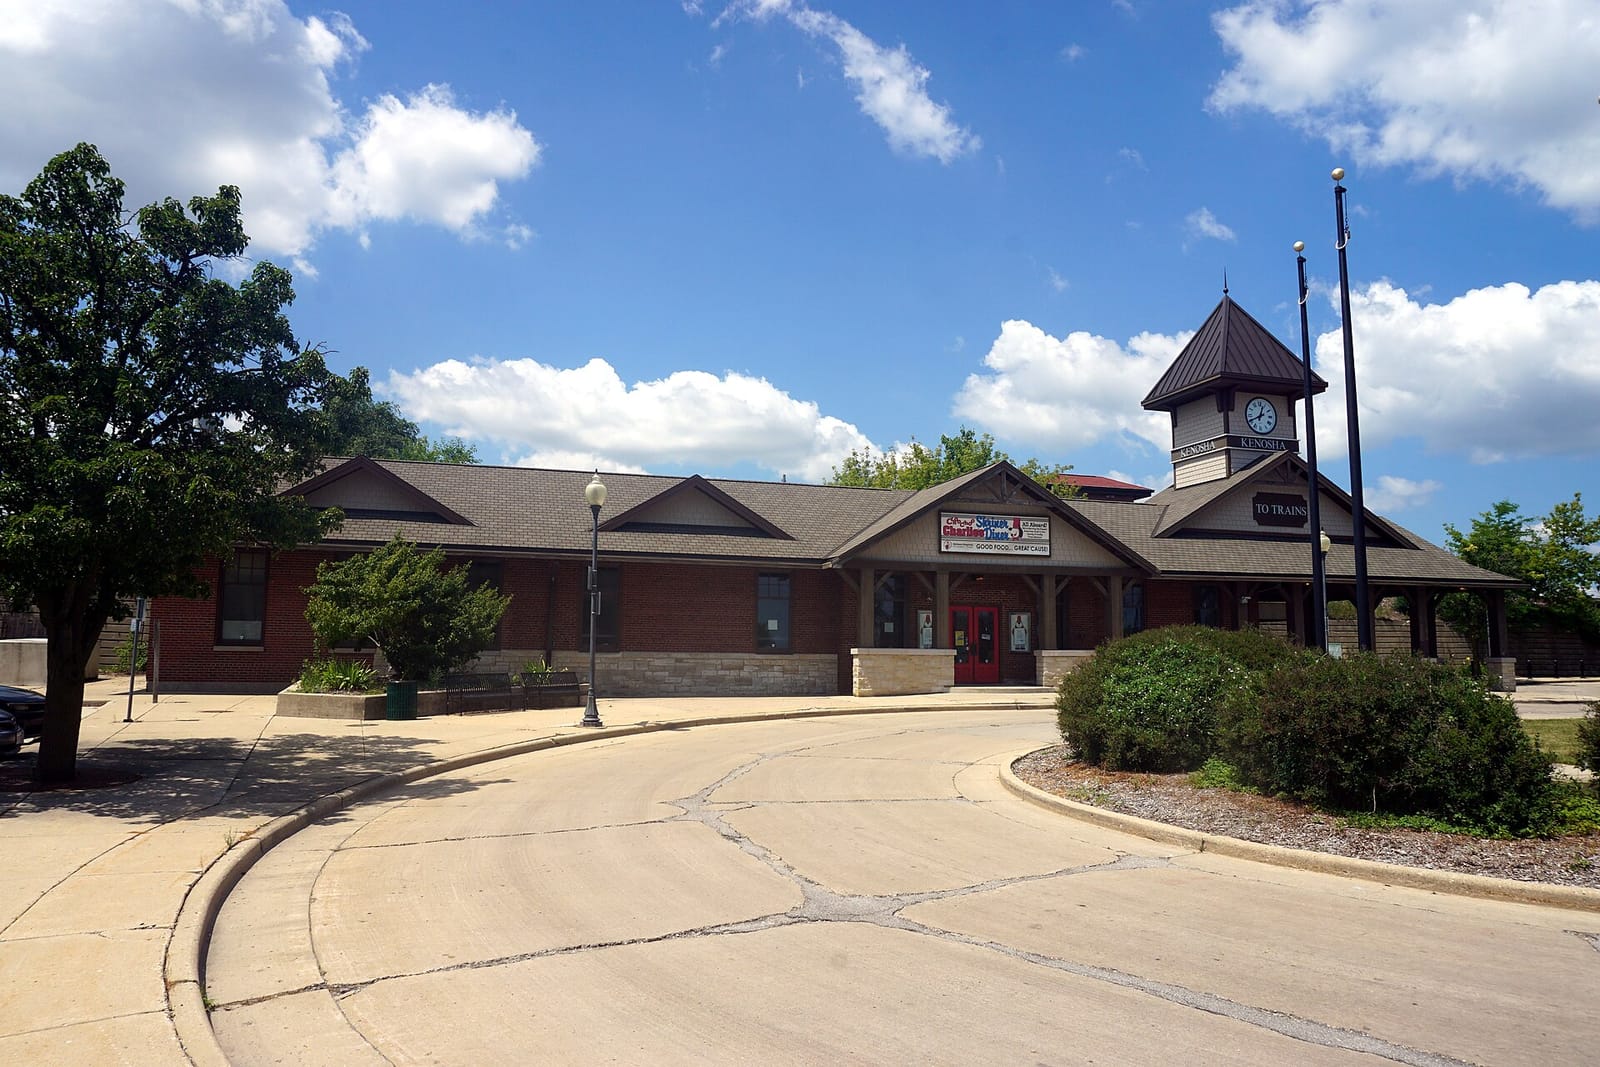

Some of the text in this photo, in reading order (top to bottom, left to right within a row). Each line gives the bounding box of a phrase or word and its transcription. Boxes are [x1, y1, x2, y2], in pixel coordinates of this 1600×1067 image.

[1180, 440, 1216, 458] KENOSHA
[1240, 438, 1286, 450] KENOSHA
[1256, 504, 1307, 516] TO TRAINS
[943, 525, 985, 538] Charlies
[984, 527, 1009, 541] Diner
